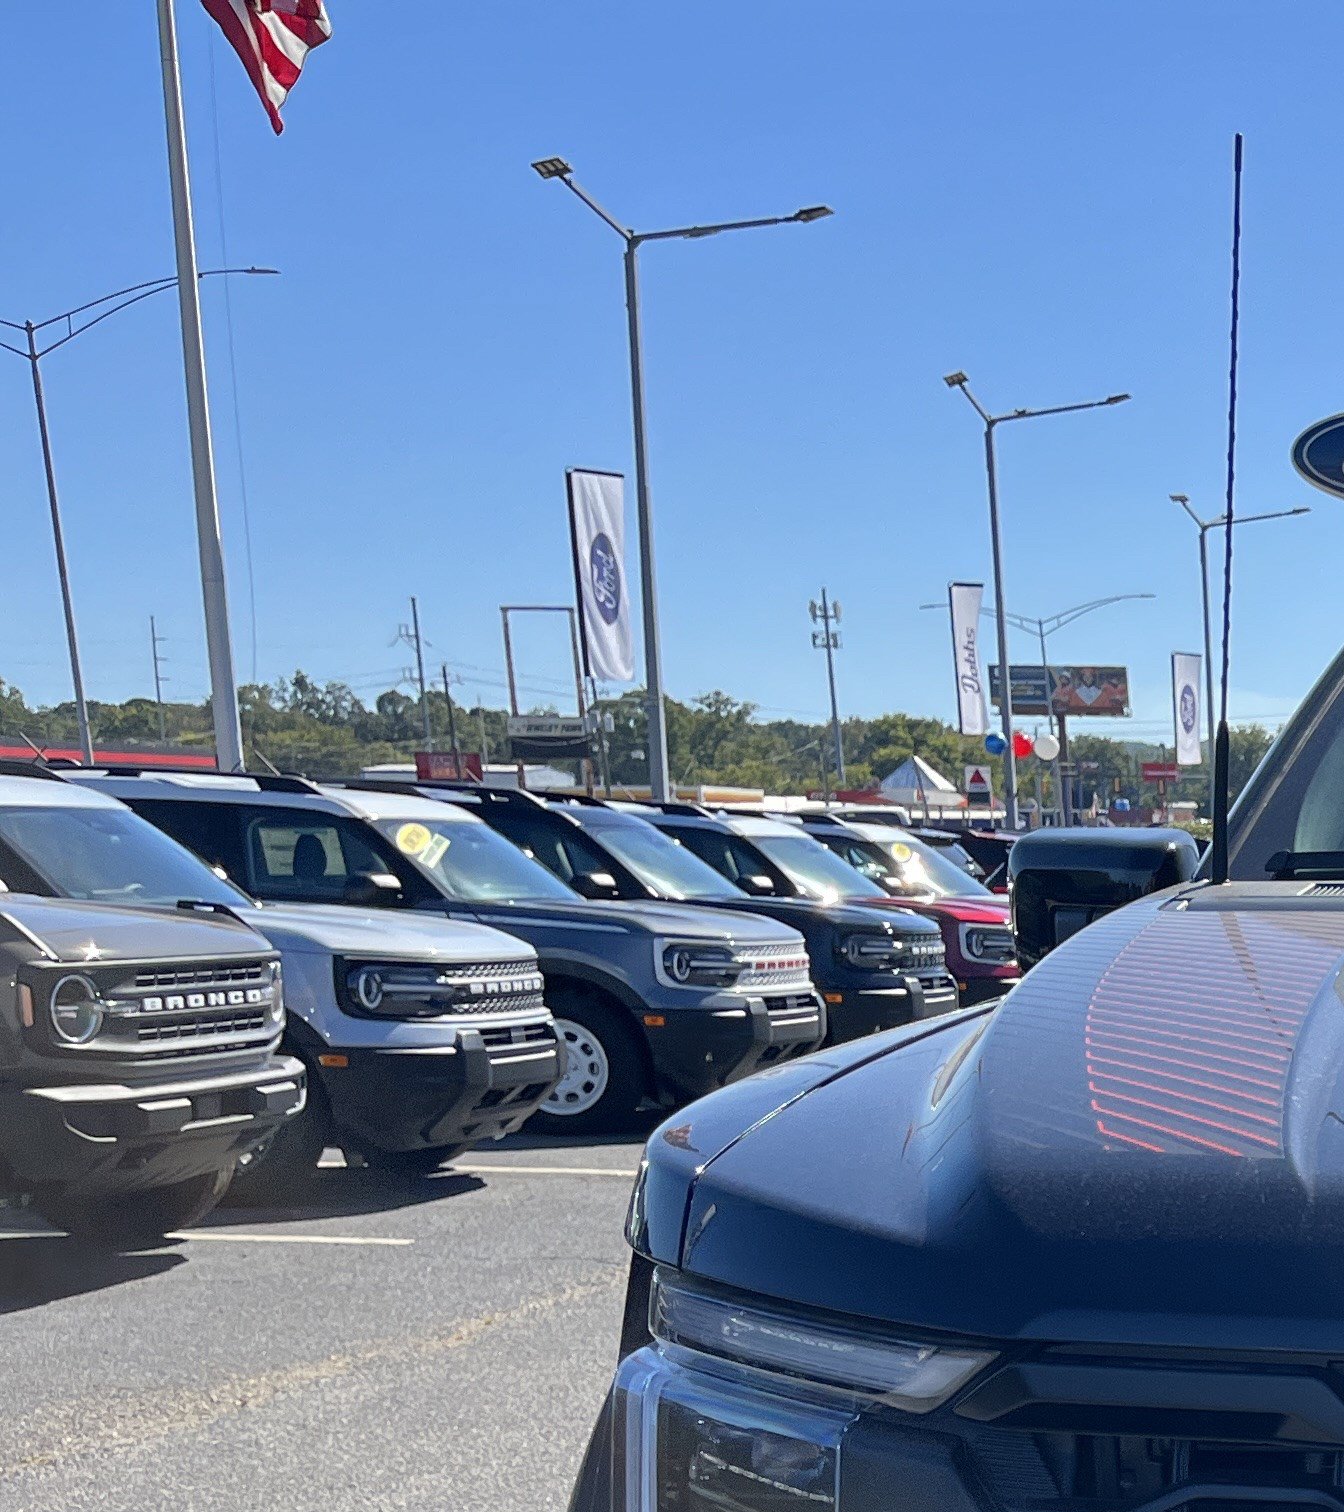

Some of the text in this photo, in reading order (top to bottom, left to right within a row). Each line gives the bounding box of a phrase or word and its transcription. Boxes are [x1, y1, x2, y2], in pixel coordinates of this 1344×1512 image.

[592, 548, 616, 610] Ford
[469, 978, 541, 995] BRONCO
[142, 989, 262, 1012] BRONCO
